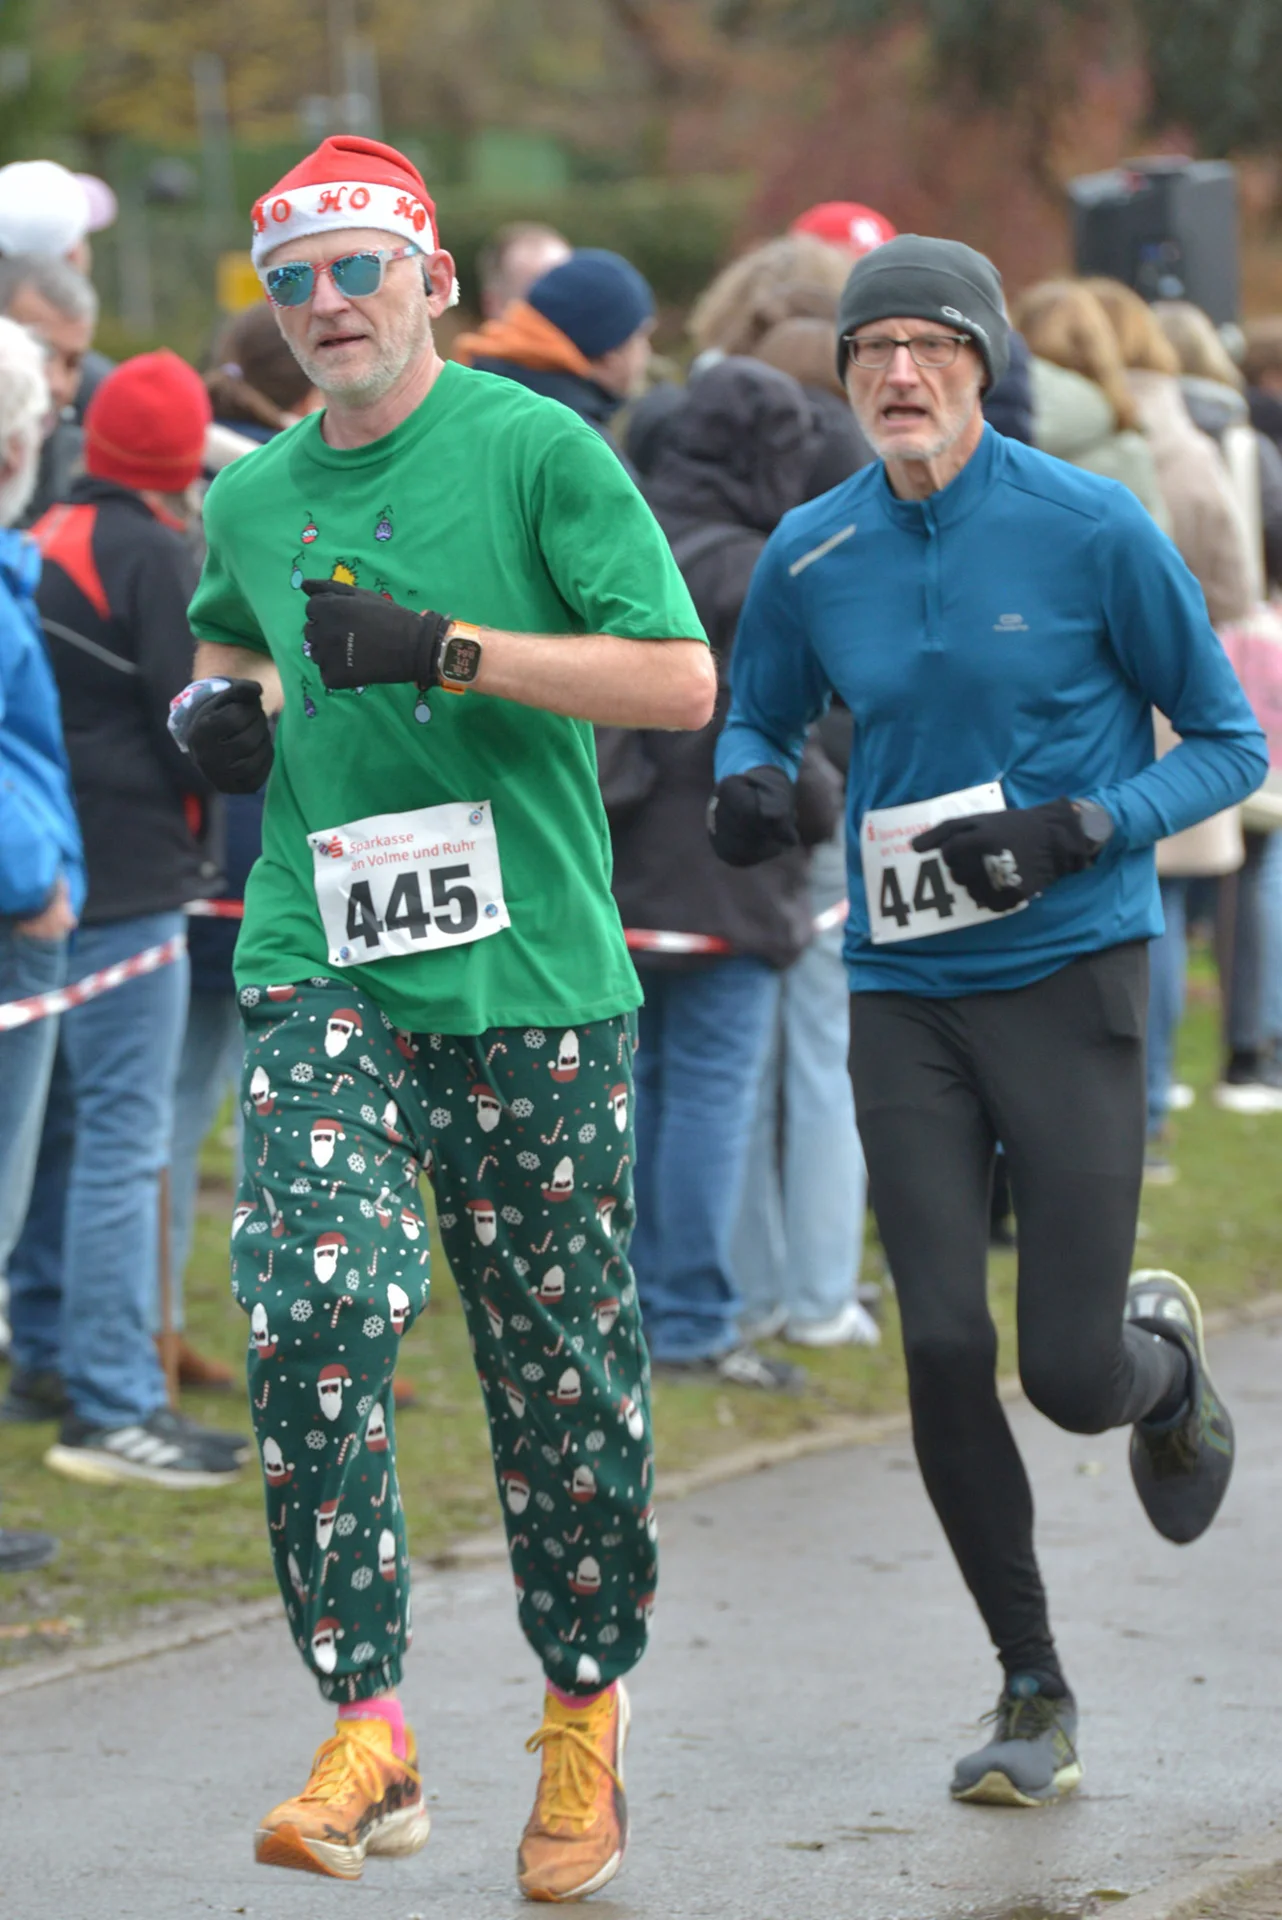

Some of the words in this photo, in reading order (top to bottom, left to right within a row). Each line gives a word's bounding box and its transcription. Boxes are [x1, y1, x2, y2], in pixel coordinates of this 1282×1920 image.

[317, 186, 371, 214] HO
[393, 196, 427, 232] HO
[350, 833, 414, 854] Sparkasse
[351, 859, 365, 872] an
[367, 851, 410, 868] Volme
[413, 846, 440, 860] und
[442, 839, 477, 854] Ruhr
[346, 863, 478, 949] 445
[880, 857, 956, 928] 44
